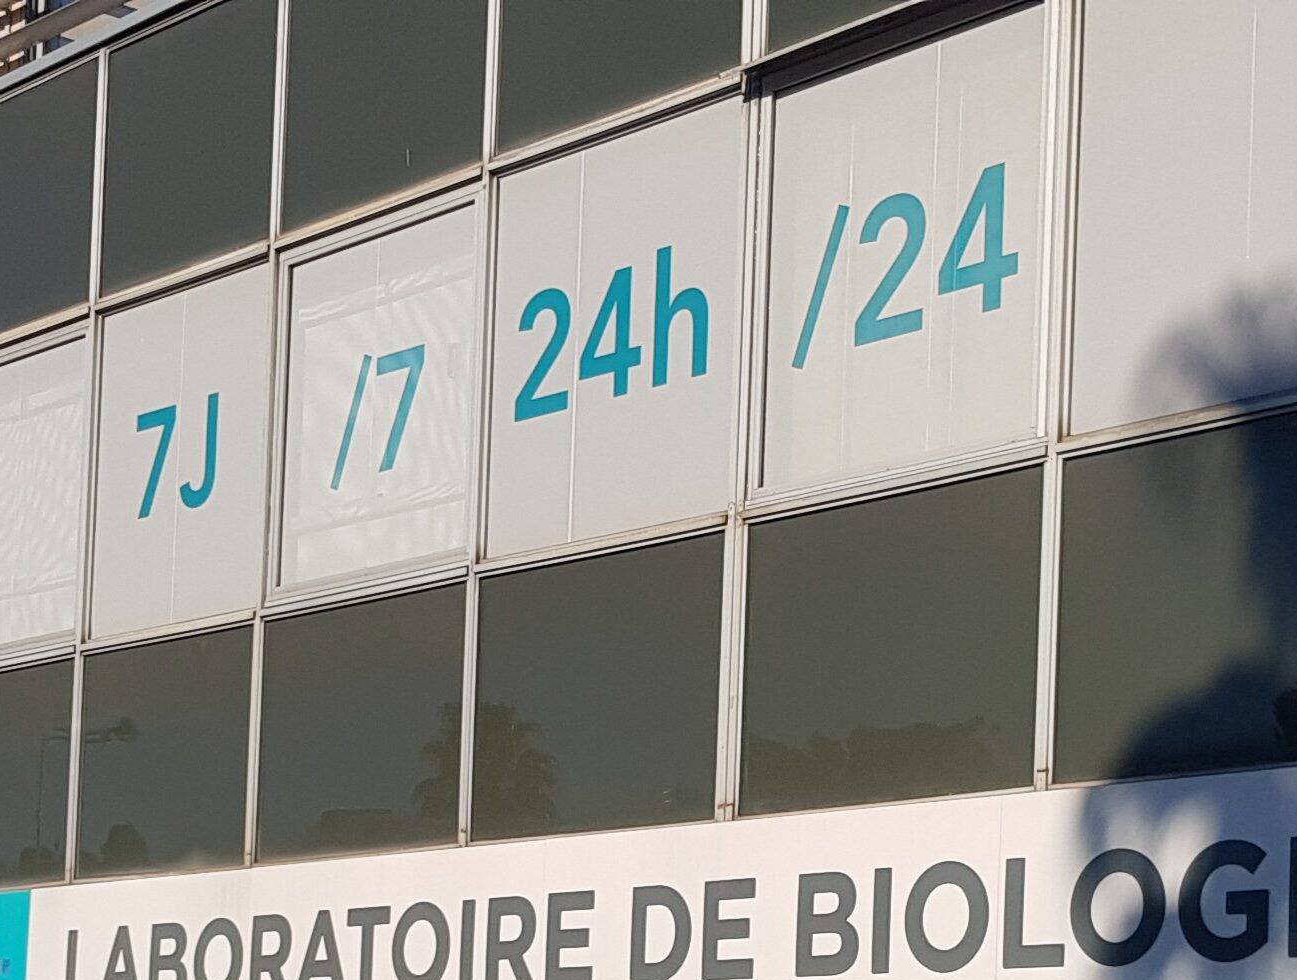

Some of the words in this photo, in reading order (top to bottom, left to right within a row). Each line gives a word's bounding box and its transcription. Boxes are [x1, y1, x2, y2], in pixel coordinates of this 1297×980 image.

[136, 392, 220, 519] 7J
[329, 343, 426, 491] /7
[513, 244, 709, 423] 24h
[790, 161, 1020, 371] /24
